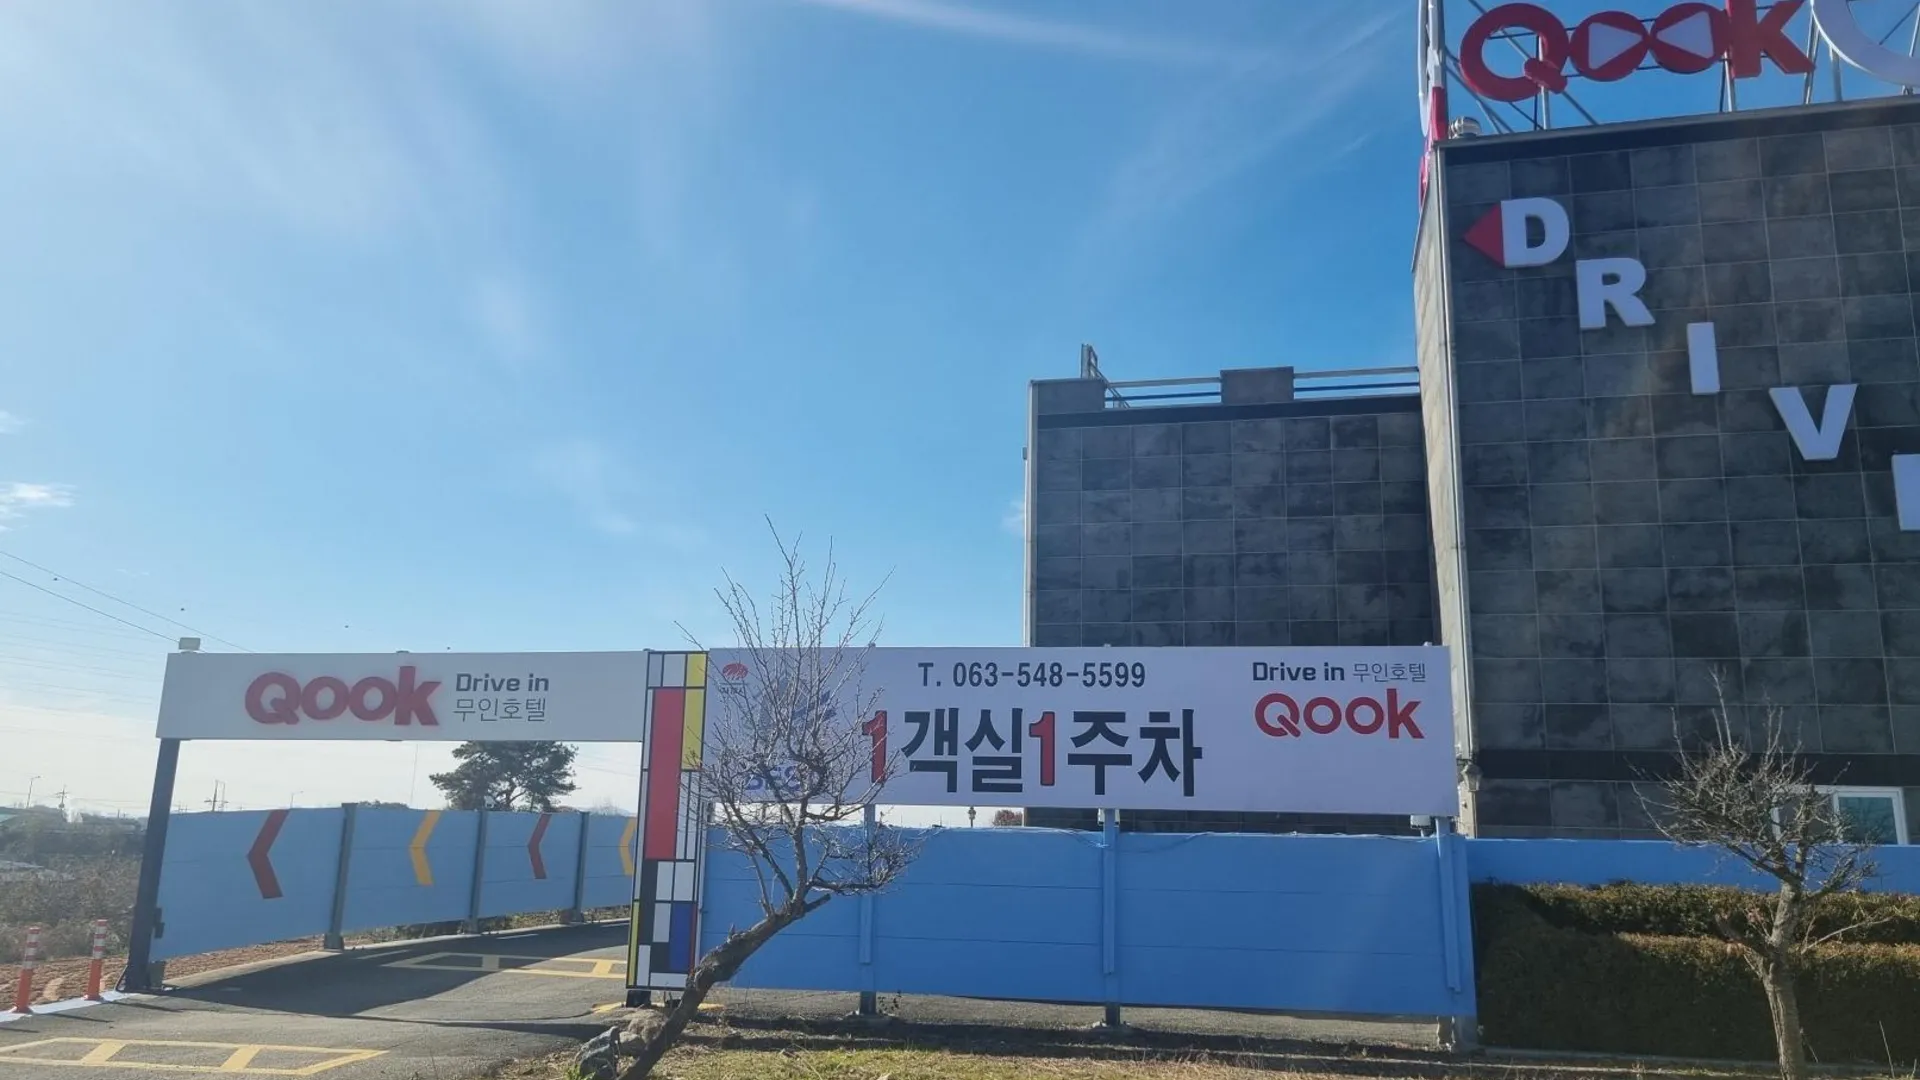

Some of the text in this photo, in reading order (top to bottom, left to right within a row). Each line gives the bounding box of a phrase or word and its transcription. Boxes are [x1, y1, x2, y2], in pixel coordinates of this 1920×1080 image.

[456, 673, 549, 692] Drive in
[917, 662, 1146, 687] T. 063-548-5599
[1253, 662, 1427, 683] Drive in 무인호텔
[245, 665, 442, 726] Qook
[453, 697, 547, 722] 무인호텔
[1255, 688, 1425, 739] Qook
